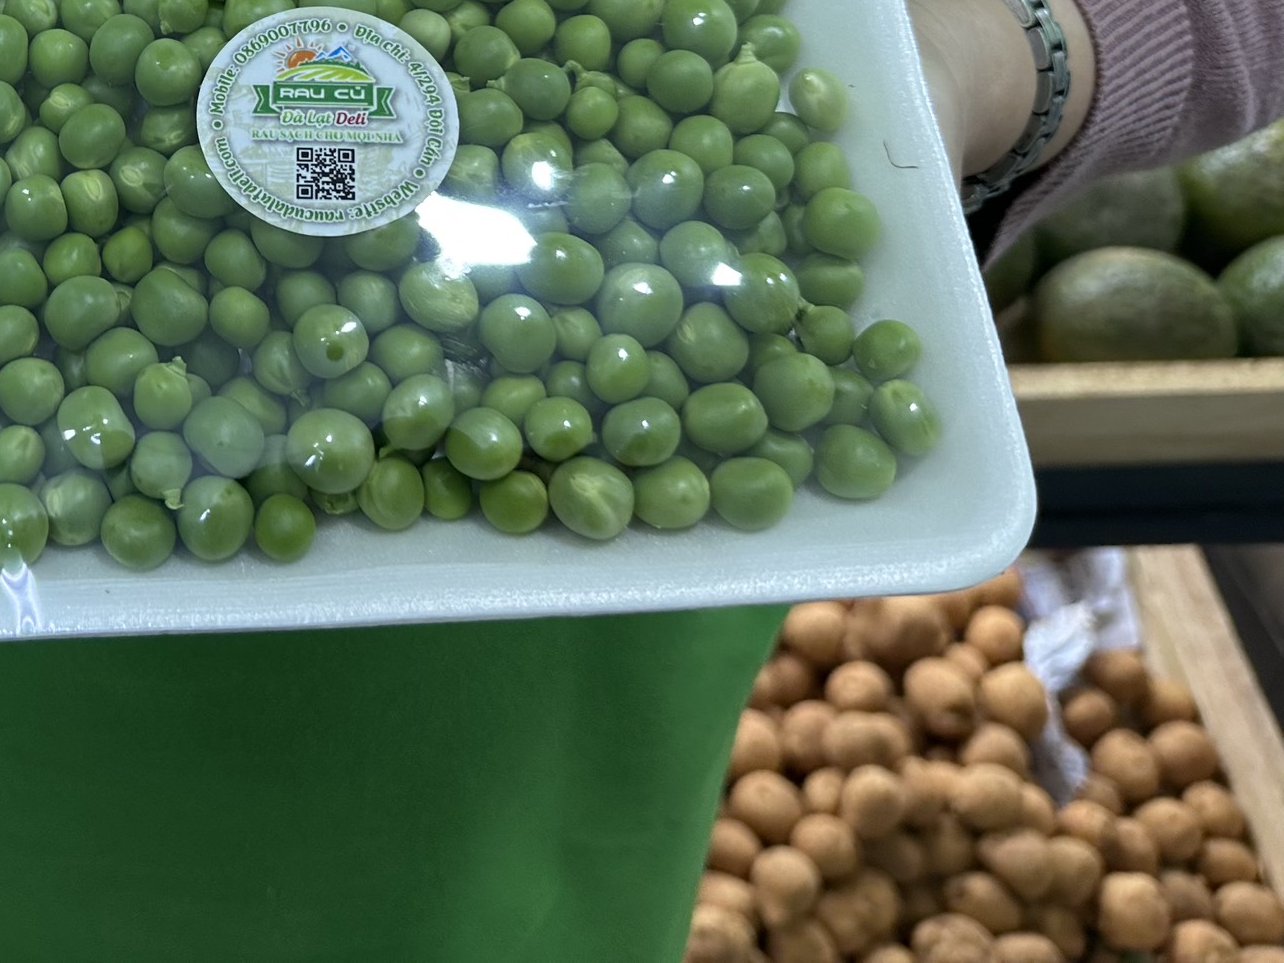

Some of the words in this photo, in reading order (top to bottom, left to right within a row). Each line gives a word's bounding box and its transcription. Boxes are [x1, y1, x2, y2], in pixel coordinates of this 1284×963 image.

[209, 64, 240, 116] Mobile:
[234, 18, 331, 65] 0869007796
[354, 24, 382, 46] Địa
[408, 61, 441, 105] 4/294
[279, 87, 325, 99] RAU
[334, 85, 366, 100] CỦ
[251, 129, 277, 139] RAU
[315, 129, 344, 140] CHO
[281, 110, 304, 126] Đà
[306, 110, 333, 128] Lạt
[334, 110, 368, 126] Deli
[214, 136, 345, 222] raucudalatdeli.com
[348, 180, 420, 220] Website:
